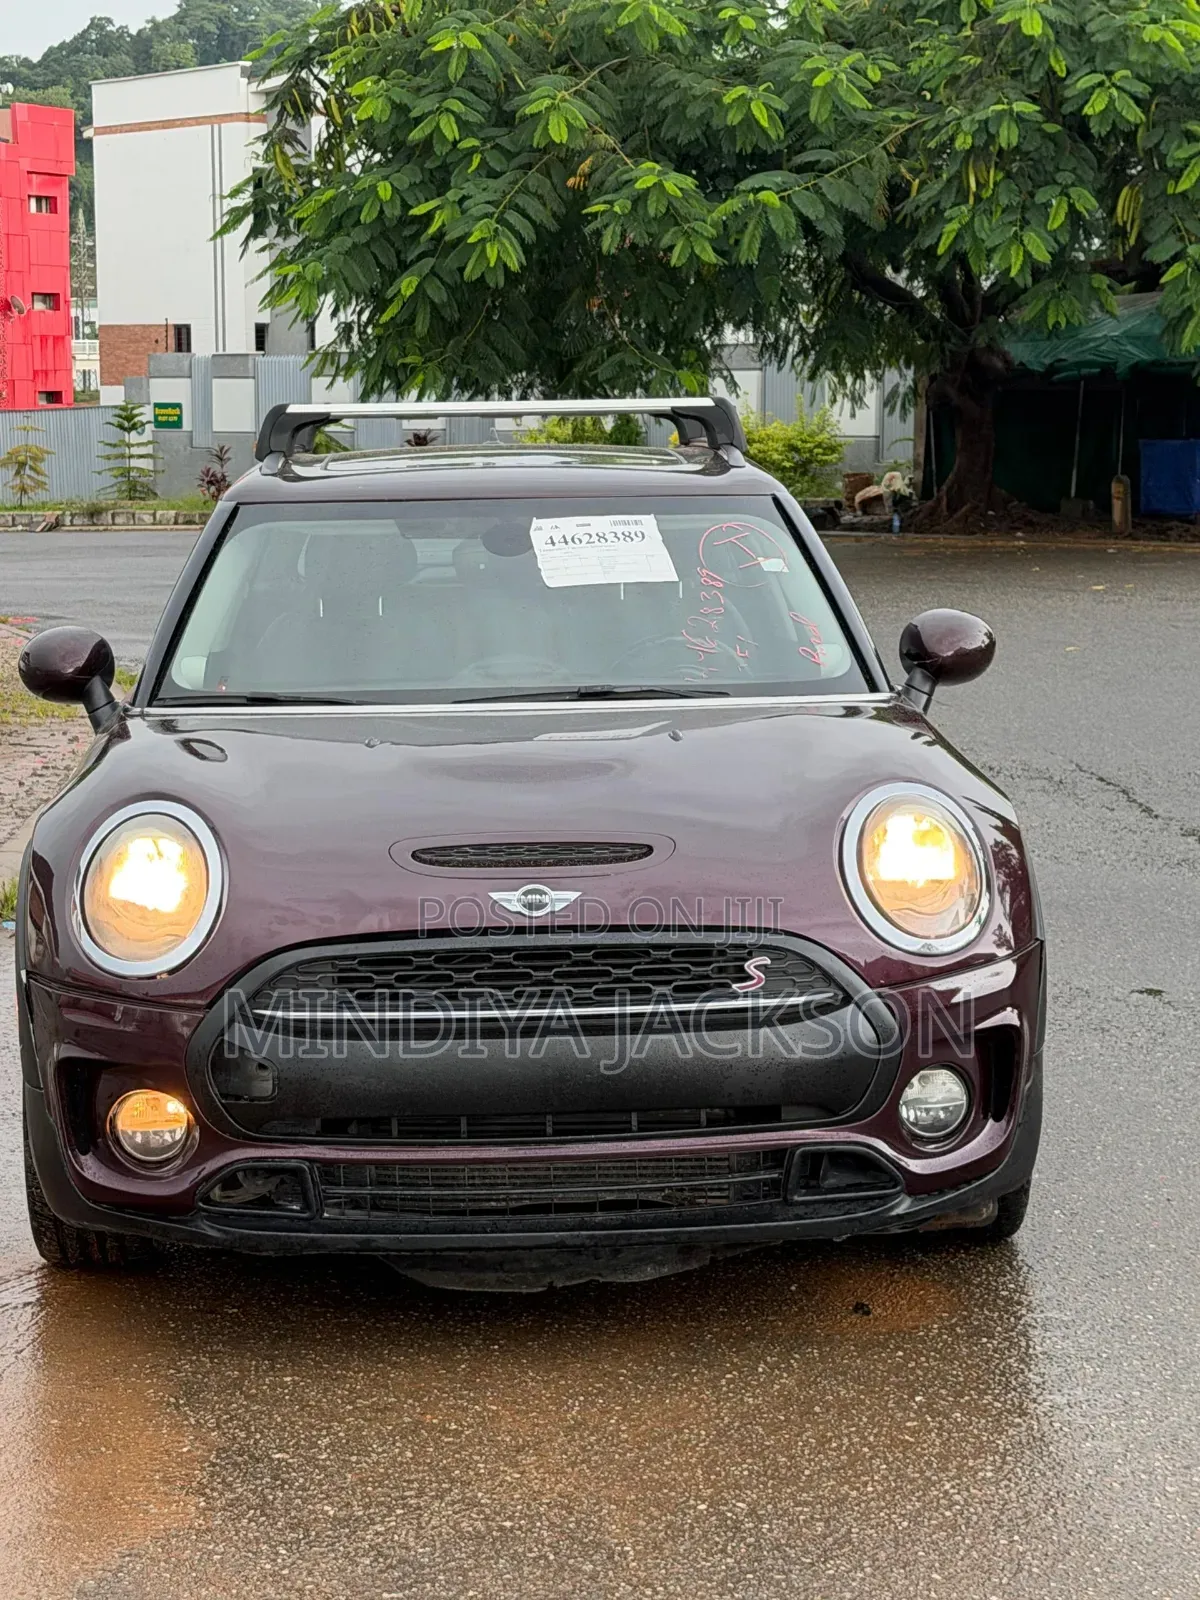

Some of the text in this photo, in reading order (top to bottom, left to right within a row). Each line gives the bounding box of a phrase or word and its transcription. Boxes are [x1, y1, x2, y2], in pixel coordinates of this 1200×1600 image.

[545, 530, 646, 547] 44628389
[520, 893, 550, 905] MINI
[731, 956, 772, 993] S
